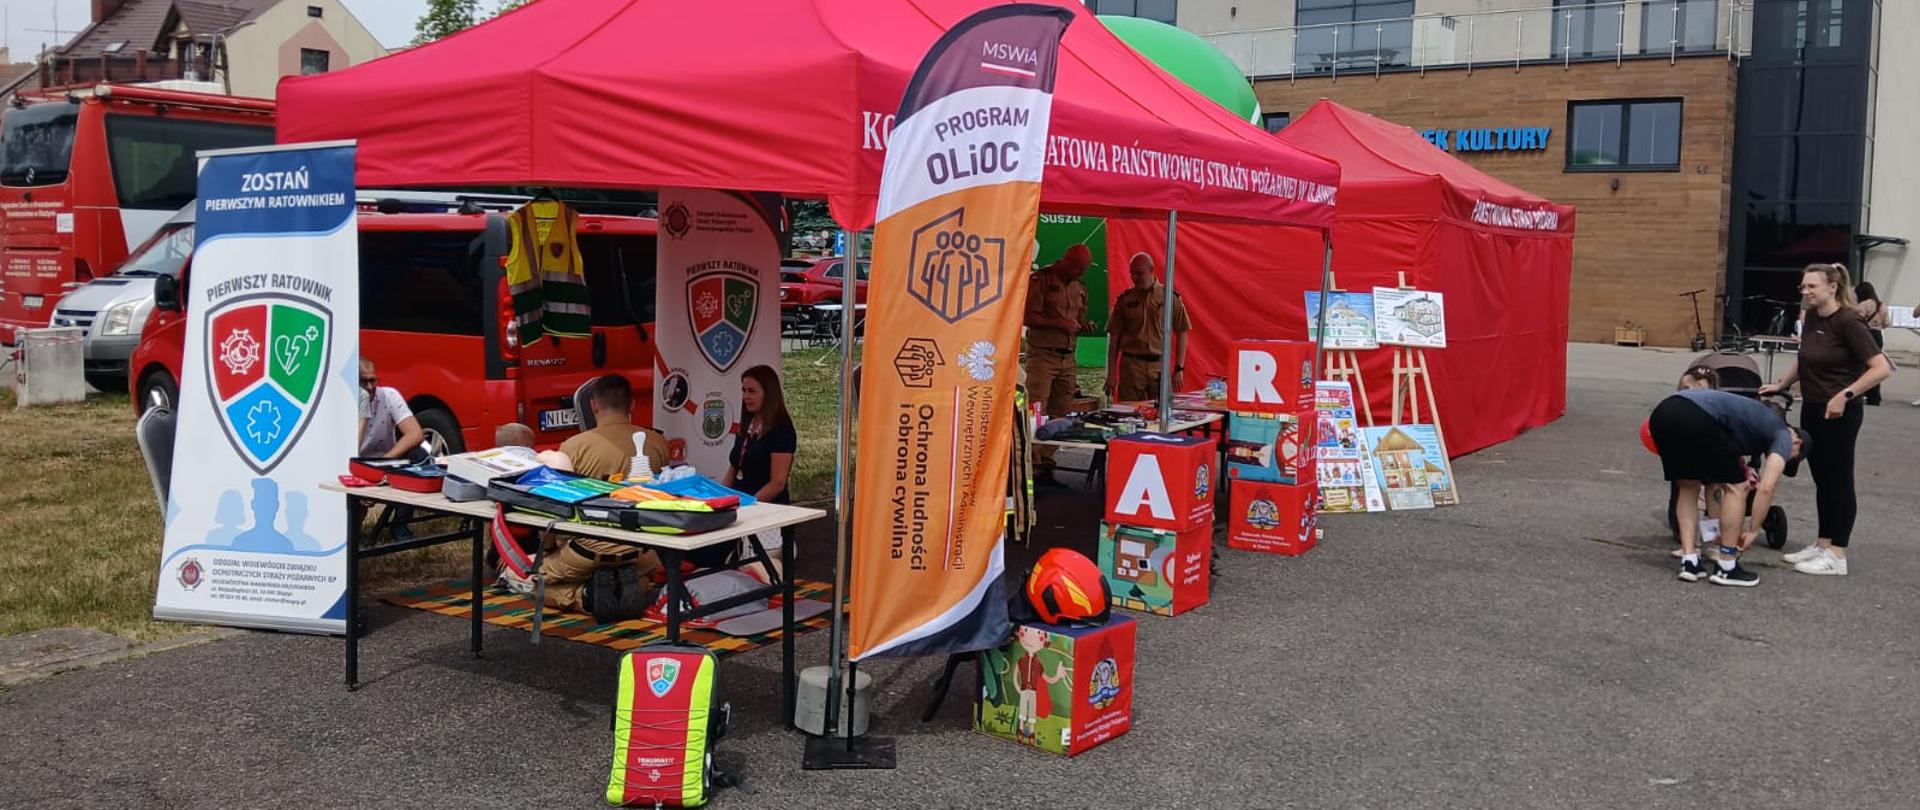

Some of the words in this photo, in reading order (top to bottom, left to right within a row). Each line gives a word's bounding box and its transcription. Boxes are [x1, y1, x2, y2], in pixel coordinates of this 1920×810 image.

[982, 40, 1038, 65] MSWiA
[935, 106, 1030, 142] PROGRAM
[1419, 130, 1449, 150] EK
[1456, 127, 1552, 151] KULTURY
[241, 165, 309, 193] ZOSTAŃ
[926, 141, 1020, 185] OLiOC
[1045, 135, 1108, 172] ATOWA
[1111, 139, 1204, 190] PAŃSTWOWEJ
[1207, 161, 1249, 191] STRAŻY
[1250, 166, 1297, 203] POŻARNEJ
[205, 196, 266, 212] PIERWSZYM
[268, 192, 346, 208] RATOWNIKIEM
[1040, 212, 1082, 225] Suszu
[206, 274, 268, 303] PIERWSZY
[271, 273, 333, 303] RATOWNIK
[1237, 350, 1285, 404] R
[895, 416, 914, 481] obrona
[914, 403, 935, 487] Ochrona
[961, 386, 978, 482] Wewnętrznych
[1114, 453, 1177, 520] A
[891, 485, 908, 560] cywilna
[910, 491, 930, 571] ludności
